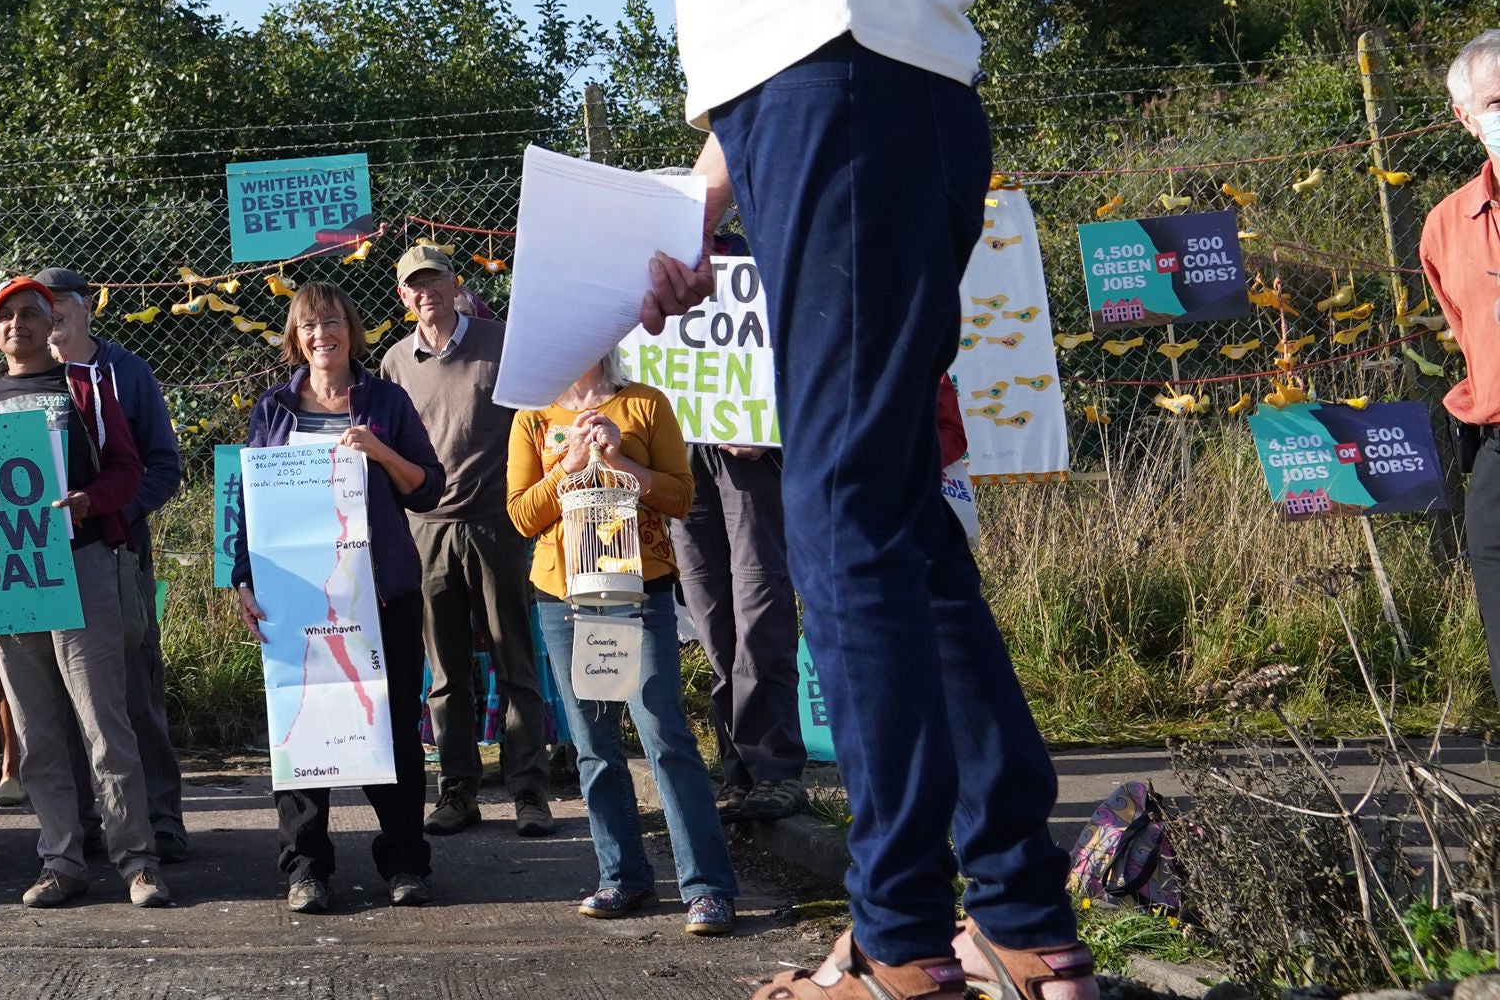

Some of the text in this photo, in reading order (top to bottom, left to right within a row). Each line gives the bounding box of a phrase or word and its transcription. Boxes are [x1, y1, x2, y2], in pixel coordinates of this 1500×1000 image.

[240, 170, 355, 195] WHITEHAVEN
[241, 185, 358, 213] DESERVES
[244, 202, 359, 234] BETTER
[1093, 243, 1145, 262] 4,500
[1187, 236, 1224, 252] 500
[1091, 258, 1152, 277] GREEN
[1158, 256, 1176, 268] or
[1183, 251, 1233, 268] COAL
[1102, 275, 1147, 292] JOBS
[1183, 266, 1238, 285] JOBS?
[679, 310, 773, 348] COA
[1366, 426, 1405, 443] 500
[1268, 434, 1324, 453] 4,500
[1364, 442, 1418, 459] COAL
[247, 453, 267, 463] LAND
[271, 449, 313, 461] PROJECTED
[1268, 449, 1333, 468] GREEN
[1339, 447, 1357, 459] or
[255, 461, 278, 469] BELOW
[281, 459, 307, 467] ANNUAL
[277, 468, 303, 477] 2050
[1368, 457, 1425, 476] JOBS?
[1282, 465, 1330, 483] JOBS
[335, 539, 367, 550] Parton
[304, 624, 362, 637] Whitehaven
[294, 765, 340, 778] Sandwith
